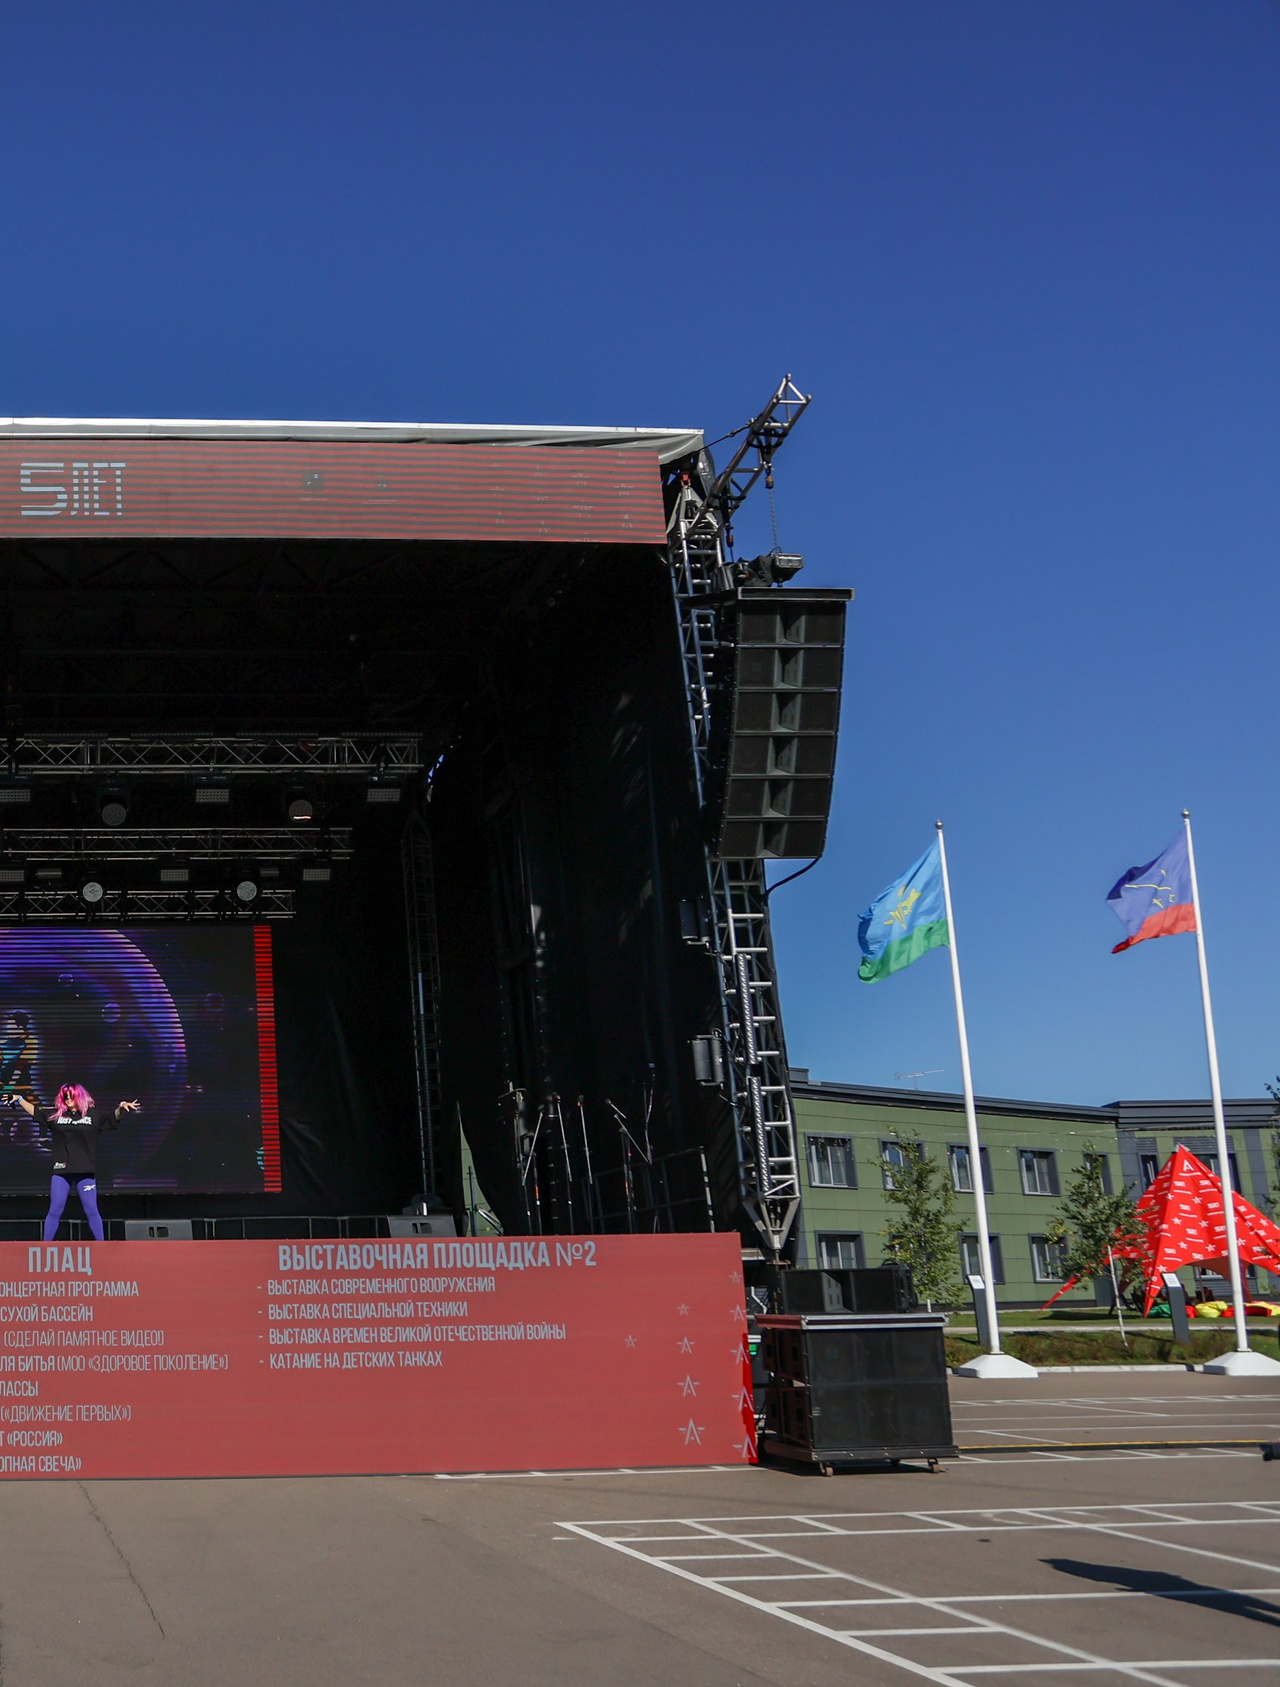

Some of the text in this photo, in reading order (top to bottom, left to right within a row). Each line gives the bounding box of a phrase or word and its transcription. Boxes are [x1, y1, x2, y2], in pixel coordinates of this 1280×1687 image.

[20, 463, 126, 516] 5 ЛЕТ
[28, 1246, 93, 1276] ПЛАЦ
[278, 1243, 429, 1271] ВЫСТАВОЧНАЯ
[434, 1241, 551, 1271] ПЛОЩАДКА
[68, 1281, 140, 1297] ПРОГРАММА
[268, 1277, 496, 1295] ВЫСТАВКА СОВРЕМЕННОГО ВООРУЖЕНИЯ
[0, 1304, 39, 1322] СУХОЙ
[41, 1304, 93, 1322] БАССЕЙН
[268, 1301, 468, 1320] ВЫСТАВКА СПЕЦИАЛЬНОЙ ТЕХНИКИ
[57, 1331, 117, 1345] ПАМЯТНОЕ
[269, 1323, 566, 1344] ВЫСТАВКА ВРЕМЕН ВЕЛИКОЙ ОТЕЧЕСТВЕННОЙ ВОЙНЫ
[18, 1356, 55, 1371] БИТЬЯ
[269, 1351, 441, 1369] КАТАНИЕ НА ДЕТСКИХ ТАНКАХ
